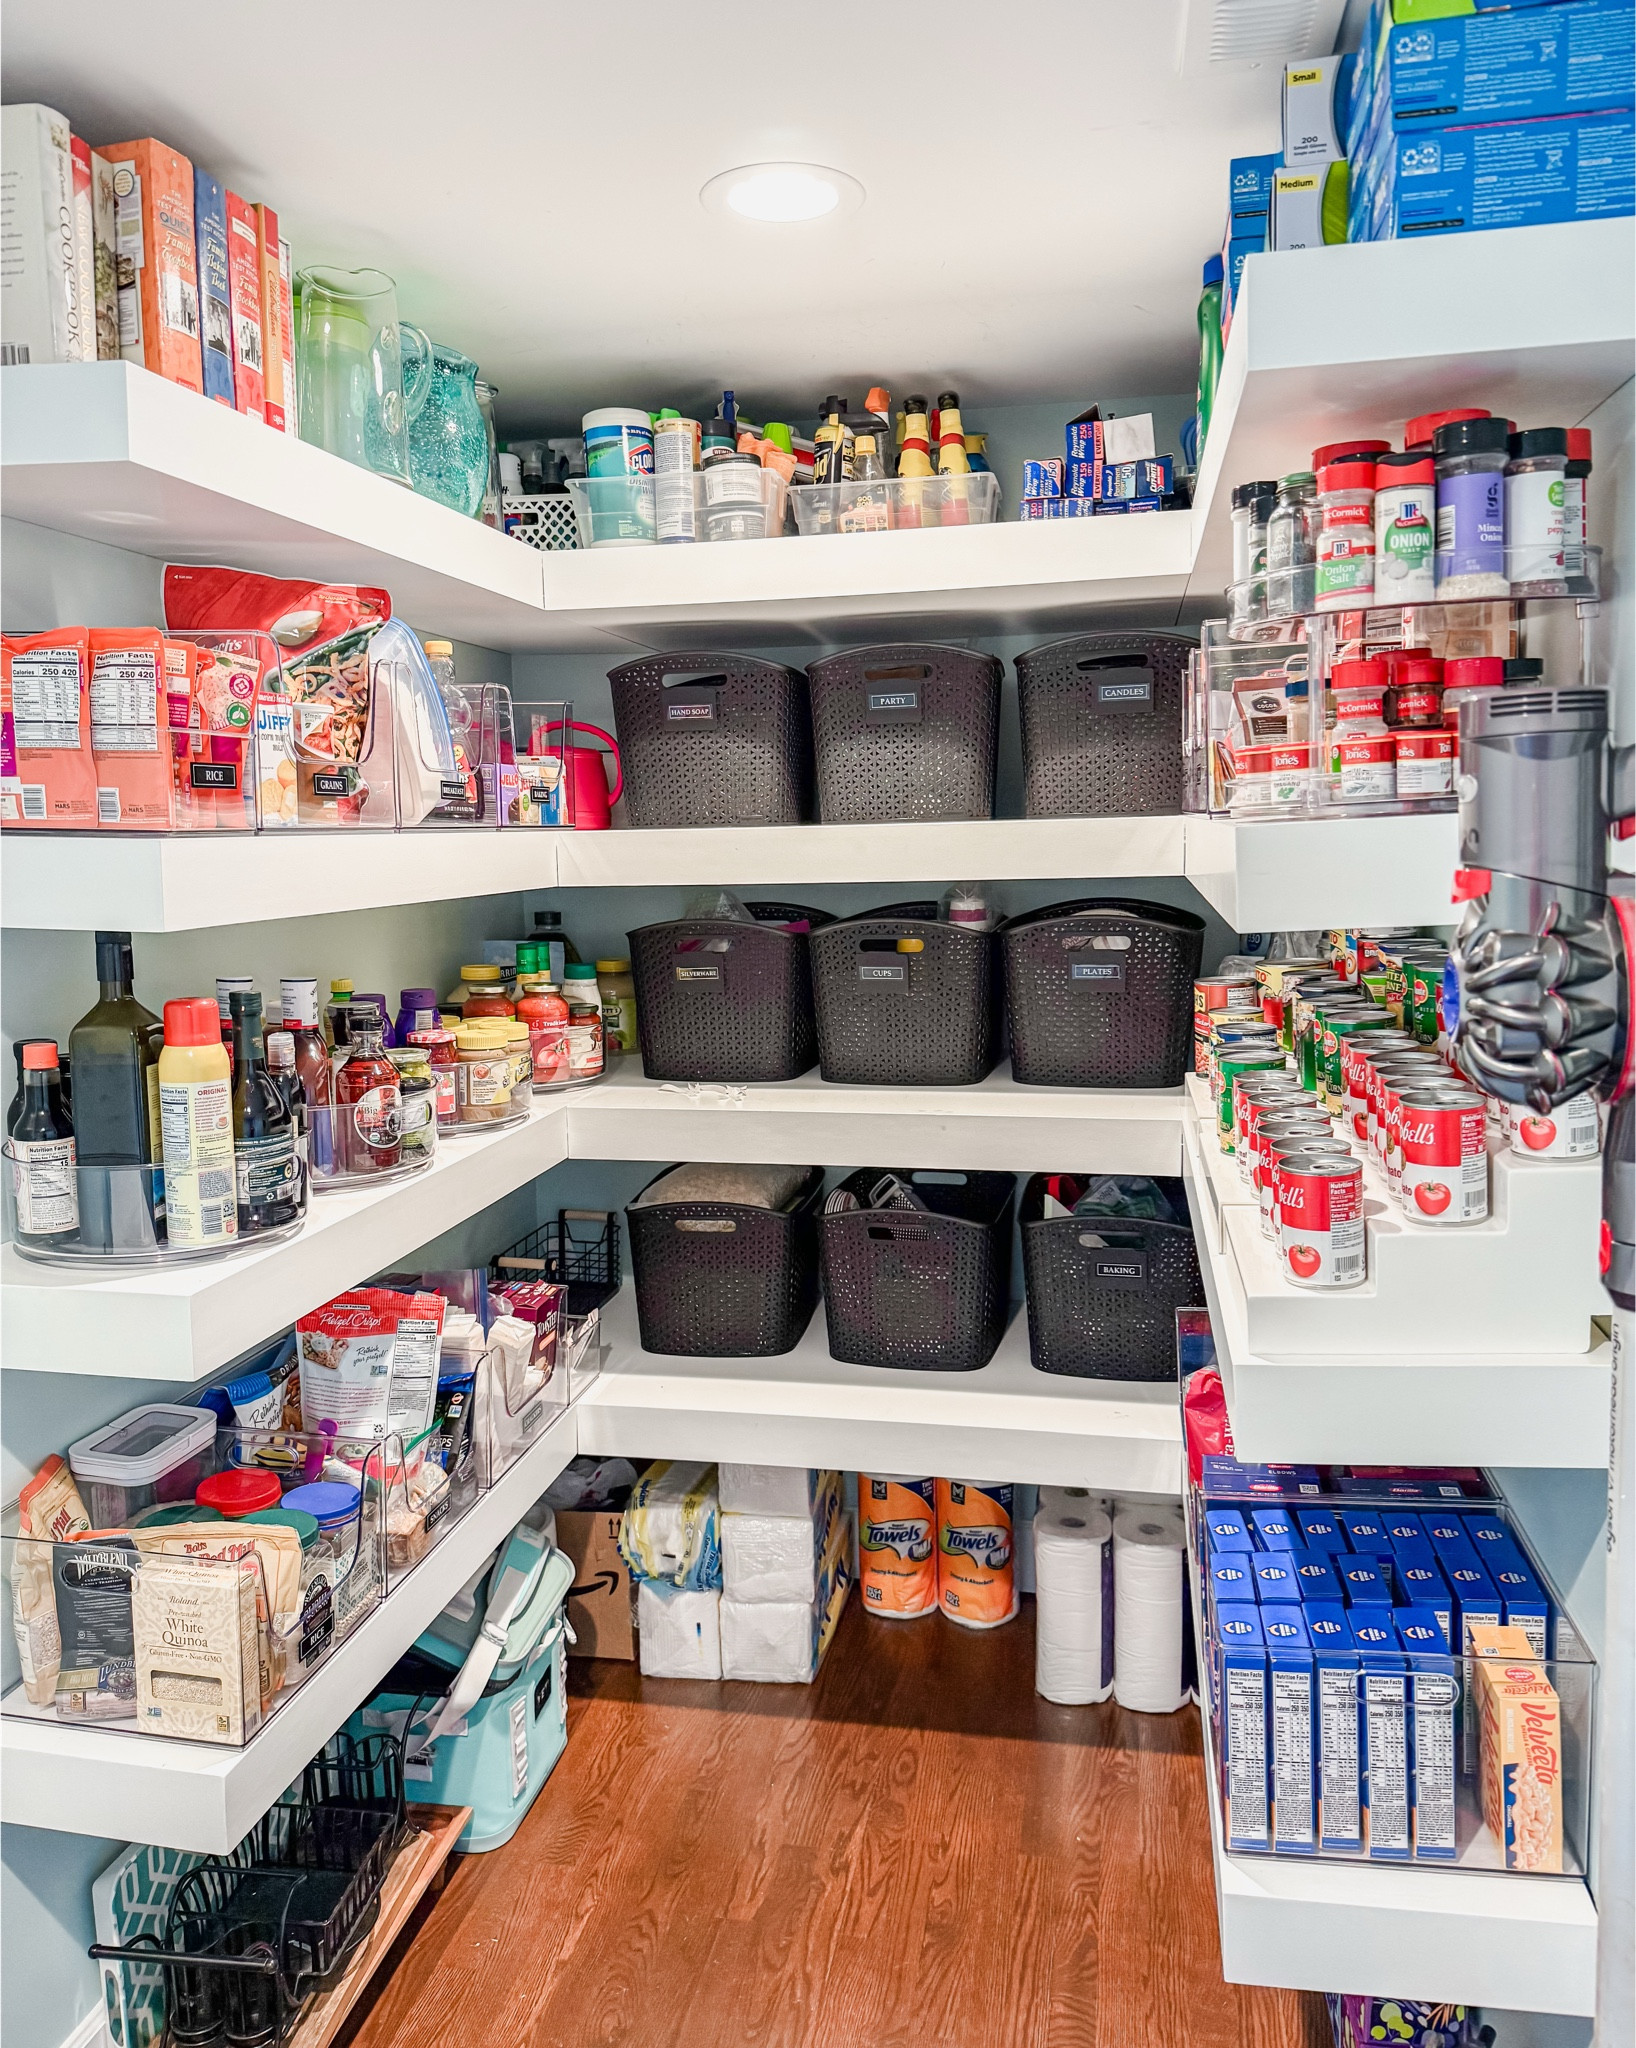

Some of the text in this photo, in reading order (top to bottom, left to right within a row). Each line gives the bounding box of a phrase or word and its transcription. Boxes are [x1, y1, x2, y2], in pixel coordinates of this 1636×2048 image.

[1293, 72, 1316, 82] Small
[1302, 136, 1318, 144] 200
[1280, 178, 1314, 189] Medium
[166, 231, 191, 257] Family
[207, 237, 226, 263] Family
[161, 245, 195, 273] Cookbook
[207, 254, 227, 280] Baking
[212, 272, 226, 292] Book
[240, 275, 258, 300] Family
[1076, 424, 1087, 459] Wrap 250
[1047, 462, 1057, 479] 150
[1121, 466, 1132, 479] 50
[1071, 463, 1079, 496] Reynolds
[1077, 462, 1088, 497] Wrap 150
[1031, 478, 1039, 496] Wrap
[1030, 503, 1038, 517] 150
[1324, 507, 1365, 519] McCormick
[1390, 533, 1430, 549] ONION
[1325, 565, 1355, 576] Onion
[1329, 574, 1349, 585] Salt
[96, 653, 124, 661] Nutrition
[137, 671, 154, 679] 420
[1105, 688, 1144, 697] CANDLES
[880, 697, 906, 705] PARTY
[1338, 702, 1379, 712] McCormick
[671, 708, 691, 716] HAND
[257, 709, 291, 731] JIFFY
[1344, 746, 1371, 760] Tone's
[1273, 753, 1300, 767] Tone's
[205, 771, 224, 782] RICE
[320, 780, 343, 791] GRAINS
[364, 1105, 378, 1115] Big
[1330, 1181, 1354, 1189] Nutrition
[1348, 1211, 1356, 1220] 90
[1103, 1266, 1136, 1275] BAKING
[319, 1312, 382, 1331] Pretzel Crisps
[357, 1345, 380, 1356] Rethink
[430, 1500, 449, 1524] SNACKS
[866, 1524, 922, 1544] Towels
[946, 1528, 999, 1550] Towels
[184, 1541, 208, 1554] Bob's
[227, 1539, 256, 1562] Mill
[165, 1617, 204, 1634] White
[1511, 1616, 1530, 1624] Nutrition
[161, 1630, 209, 1648] Quinoa
[310, 1625, 325, 1647] RICE
[149, 1648, 223, 1663] Gluten-Free Non-GMO
[1230, 1670, 1249, 1678] Nutrition
[1291, 1704, 1300, 1712] 250
[1300, 1704, 1310, 1712] 350
[1338, 1701, 1347, 1709] 250
[1369, 1710, 1404, 1718] Calories 250 350
[1520, 1702, 1560, 1785] Velveeta
